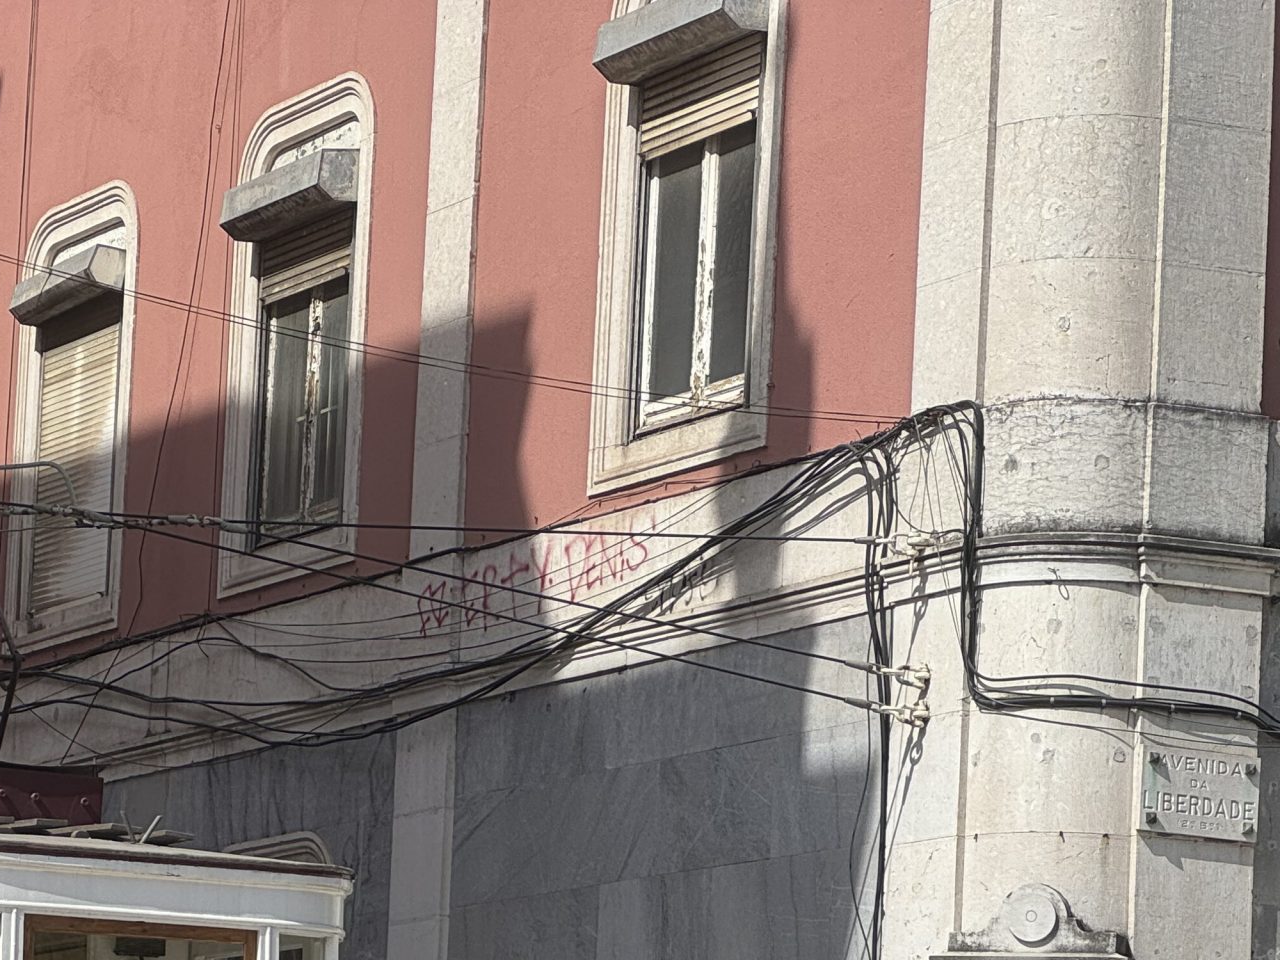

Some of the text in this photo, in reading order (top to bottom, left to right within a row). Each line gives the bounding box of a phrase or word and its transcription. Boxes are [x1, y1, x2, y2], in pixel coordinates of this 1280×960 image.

[1160, 753, 1245, 779] AVENIDA
[1190, 779, 1210, 791] DA
[1143, 790, 1255, 822] LIBERDADE
